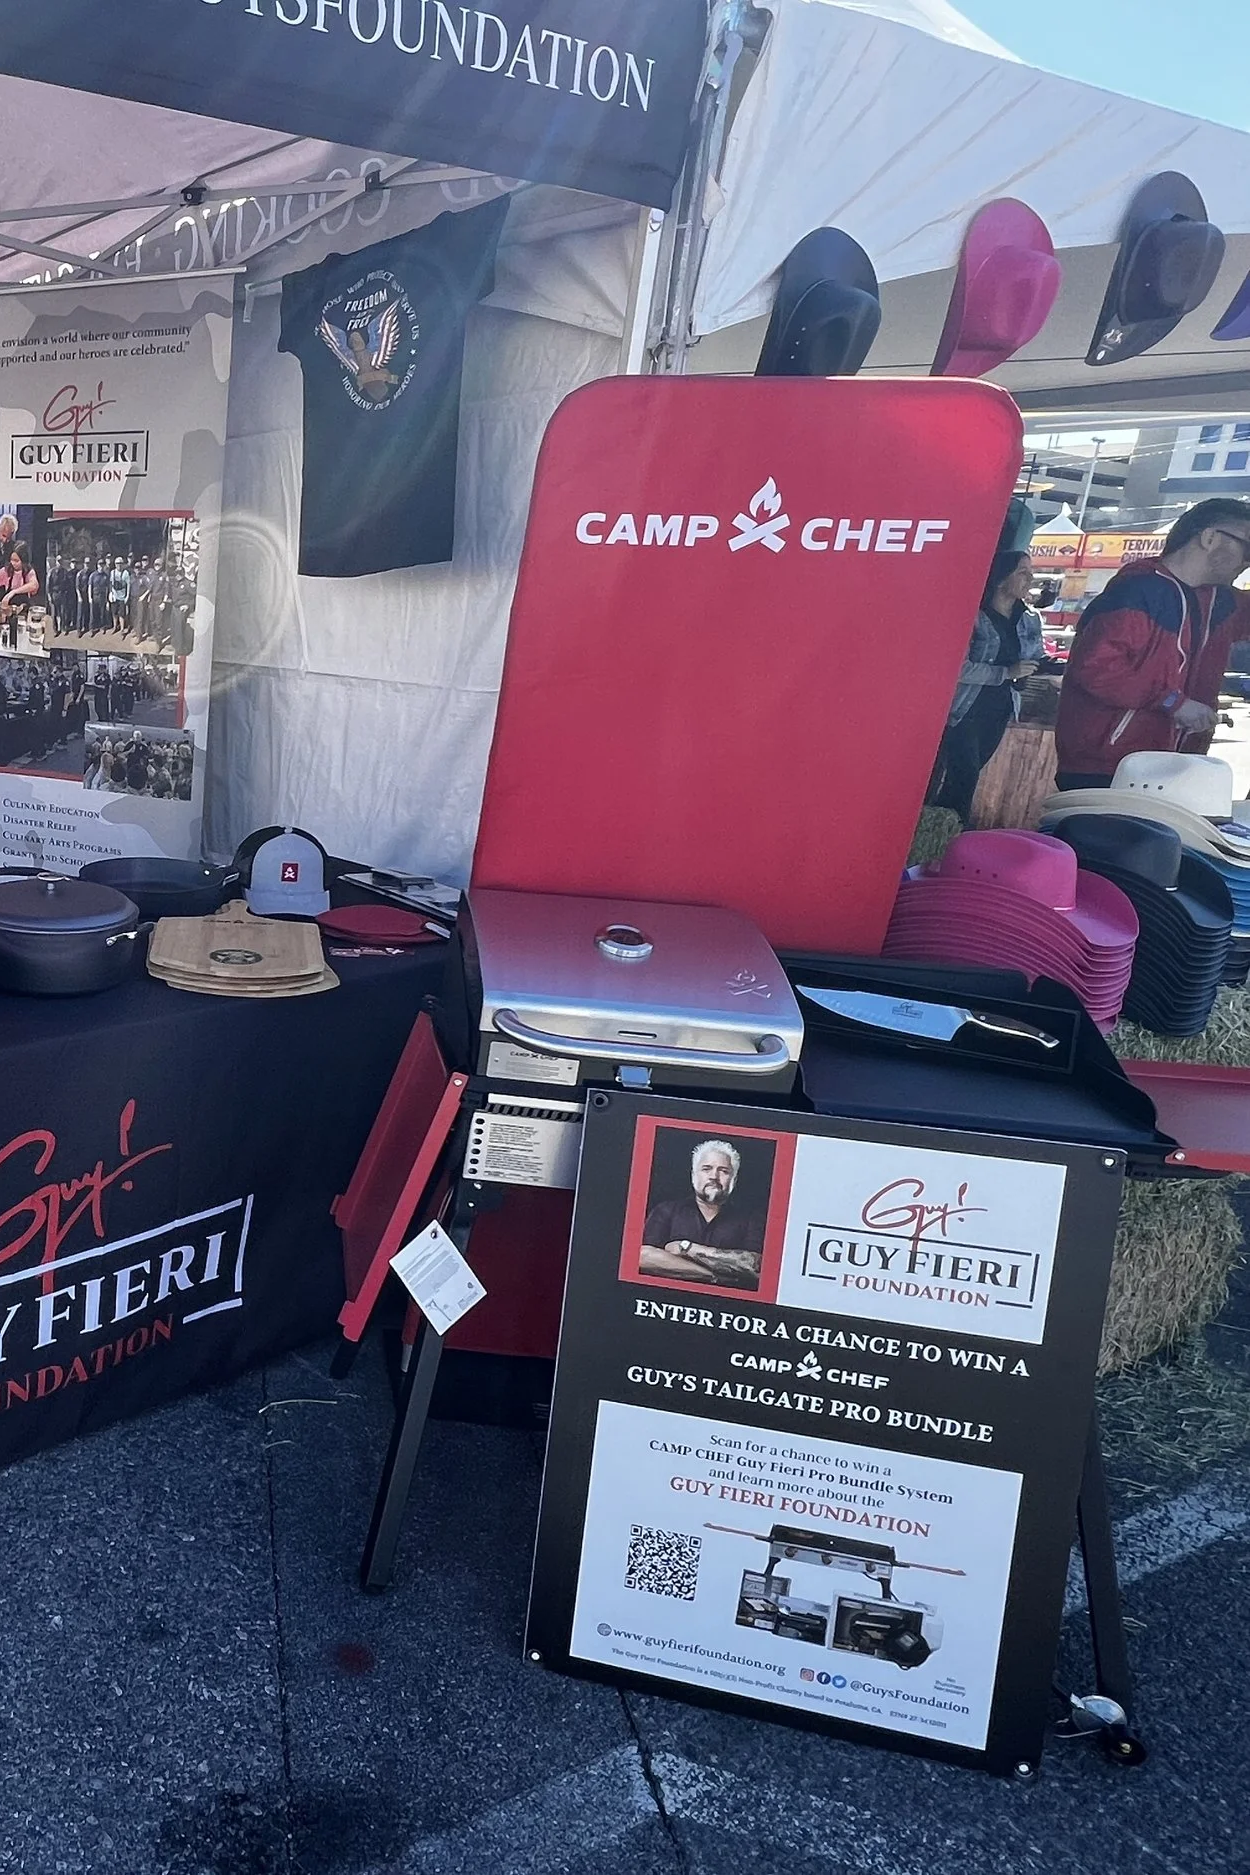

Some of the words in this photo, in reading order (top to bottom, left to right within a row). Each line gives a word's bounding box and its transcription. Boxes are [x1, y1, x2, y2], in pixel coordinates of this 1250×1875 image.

[344, 288, 388, 313] FREEDOM
[2, 336, 40, 348] envision
[50, 332, 78, 344] world
[80, 330, 110, 342] where
[112, 331, 129, 340] our
[132, 325, 192, 338] community
[40, 350, 57, 362] and
[59, 351, 76, 360] our
[78, 348, 110, 360] heroes
[113, 348, 128, 357] are
[20, 444, 68, 465] GUY
[72, 442, 139, 464] FIERI
[35, 470, 121, 483] FOUNDATION
[576, 512, 719, 547] CAMP
[800, 518, 950, 553] CHEF
[2, 798, 46, 812] CULINARY
[50, 804, 100, 819] EDUCATION
[3, 814, 44, 828] DISASTER
[47, 820, 77, 832] RELIEF
[3, 831, 46, 844] CULINARY
[49, 837, 71, 848] ARTS
[73, 841, 122, 856] PROGRAMS
[3, 847, 37, 859] GRANTS
[40, 853, 57, 862] AND
[818, 1238, 902, 1272] GUY
[904, 1249, 1022, 1290] FIERI
[33, 1231, 226, 1350] FIERI
[841, 1274, 991, 1308] FOUNDATION
[634, 1299, 714, 1328] ENTER
[718, 1312, 768, 1337] FOR
[771, 1321, 791, 1340] A
[796, 1325, 901, 1358] CHANCE
[906, 1341, 942, 1363] TO
[947, 1347, 1006, 1374] WIN
[1009, 1358, 1030, 1378] A
[730, 1352, 793, 1374] CAMP
[826, 1369, 890, 1390] CHEF
[702, 1378, 824, 1416] TAILGATE
[829, 1400, 881, 1425] PRO
[886, 1408, 995, 1444] BUNDLE
[649, 1439, 692, 1455] CAMP
[695, 1448, 734, 1465] CHEF
[736, 1456, 767, 1472] Guy
[770, 1462, 805, 1478] Fieri
[808, 1469, 835, 1484] Pro
[838, 1473, 894, 1494] Bundle
[898, 1484, 953, 1506] System
[709, 1434, 742, 1451] Scan
[745, 1439, 767, 1455] for
[770, 1447, 777, 1455] a
[781, 1447, 832, 1465] chance
[835, 1457, 848, 1469] to
[852, 1460, 879, 1475] win
[882, 1467, 892, 1477] a
[708, 1466, 734, 1482] and
[738, 1471, 774, 1489] learn
[777, 1481, 814, 1495] more
[817, 1485, 857, 1504] about
[861, 1494, 884, 1509] the
[669, 1476, 714, 1497] GUY
[718, 1486, 774, 1509] FIERI
[779, 1498, 932, 1538] FOUNDATION
[612, 1626, 786, 1677] www.guyfierifoundation.org
[850, 1678, 970, 1716] @GuysFoundation
